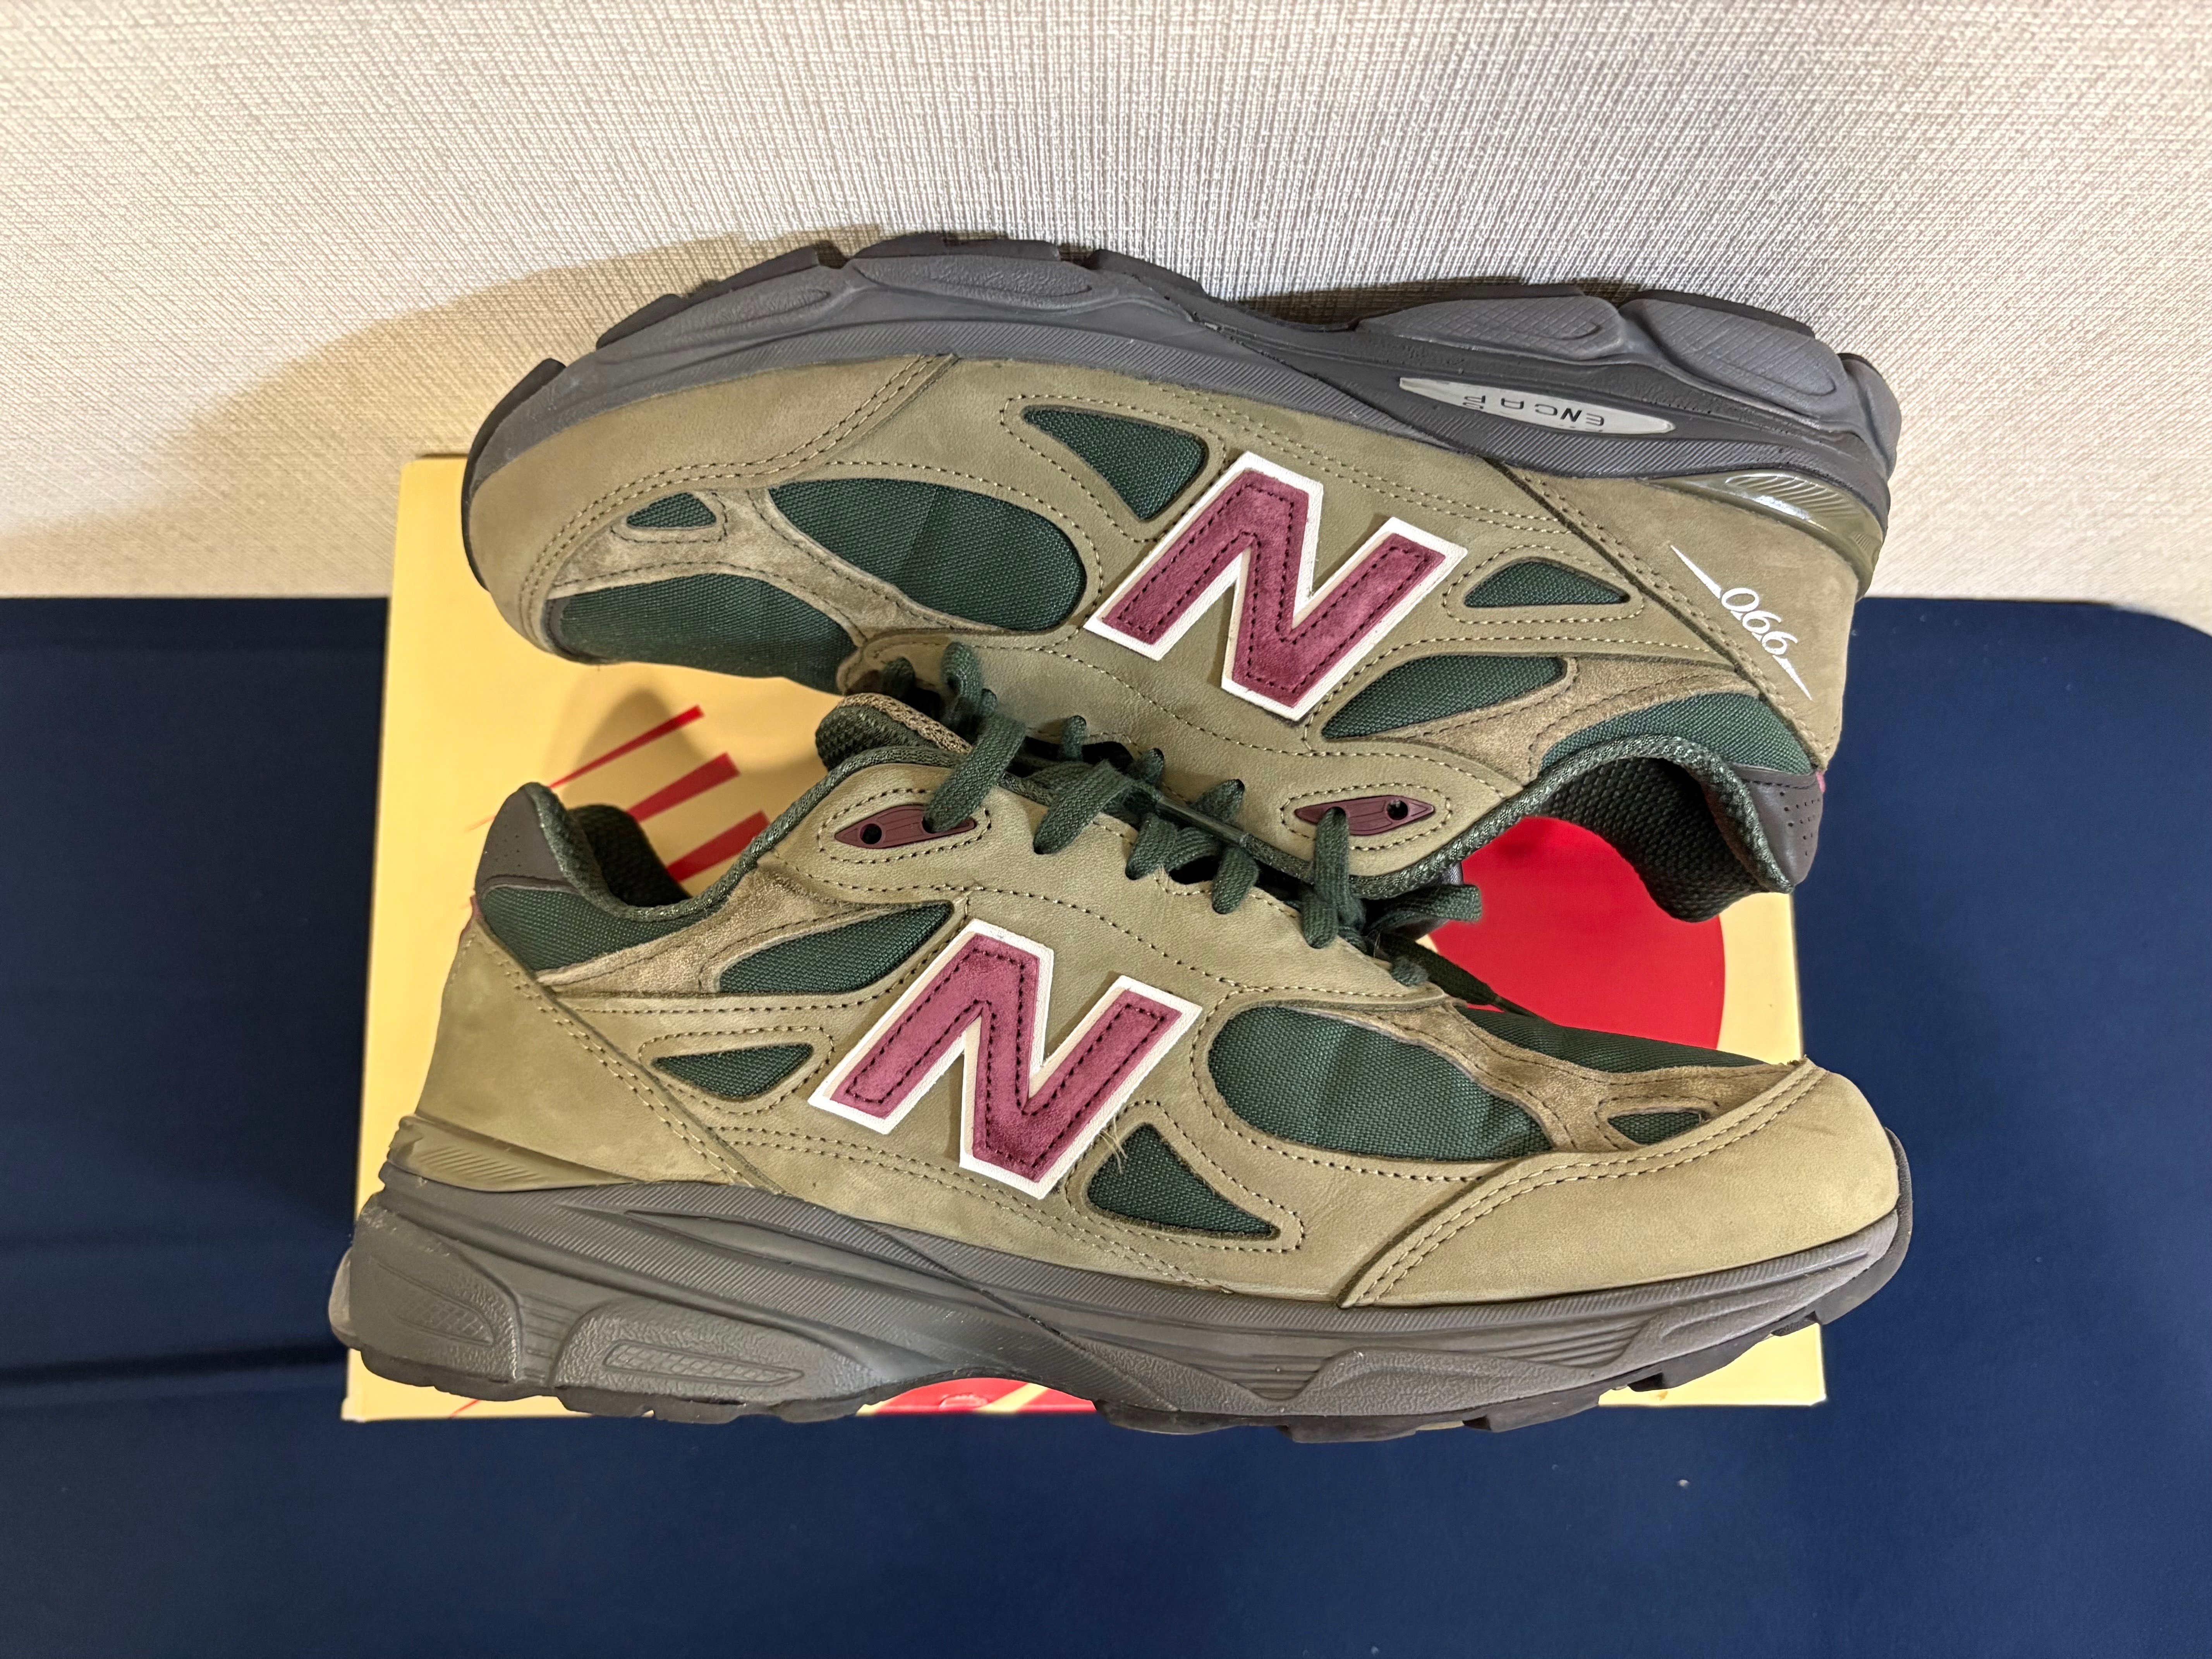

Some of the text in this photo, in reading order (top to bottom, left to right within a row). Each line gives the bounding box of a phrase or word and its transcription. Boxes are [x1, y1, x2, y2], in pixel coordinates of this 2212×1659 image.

[1463, 395, 1604, 426] ENCAP
[1084, 451, 1468, 721] N
[808, 918, 1202, 1199] N
